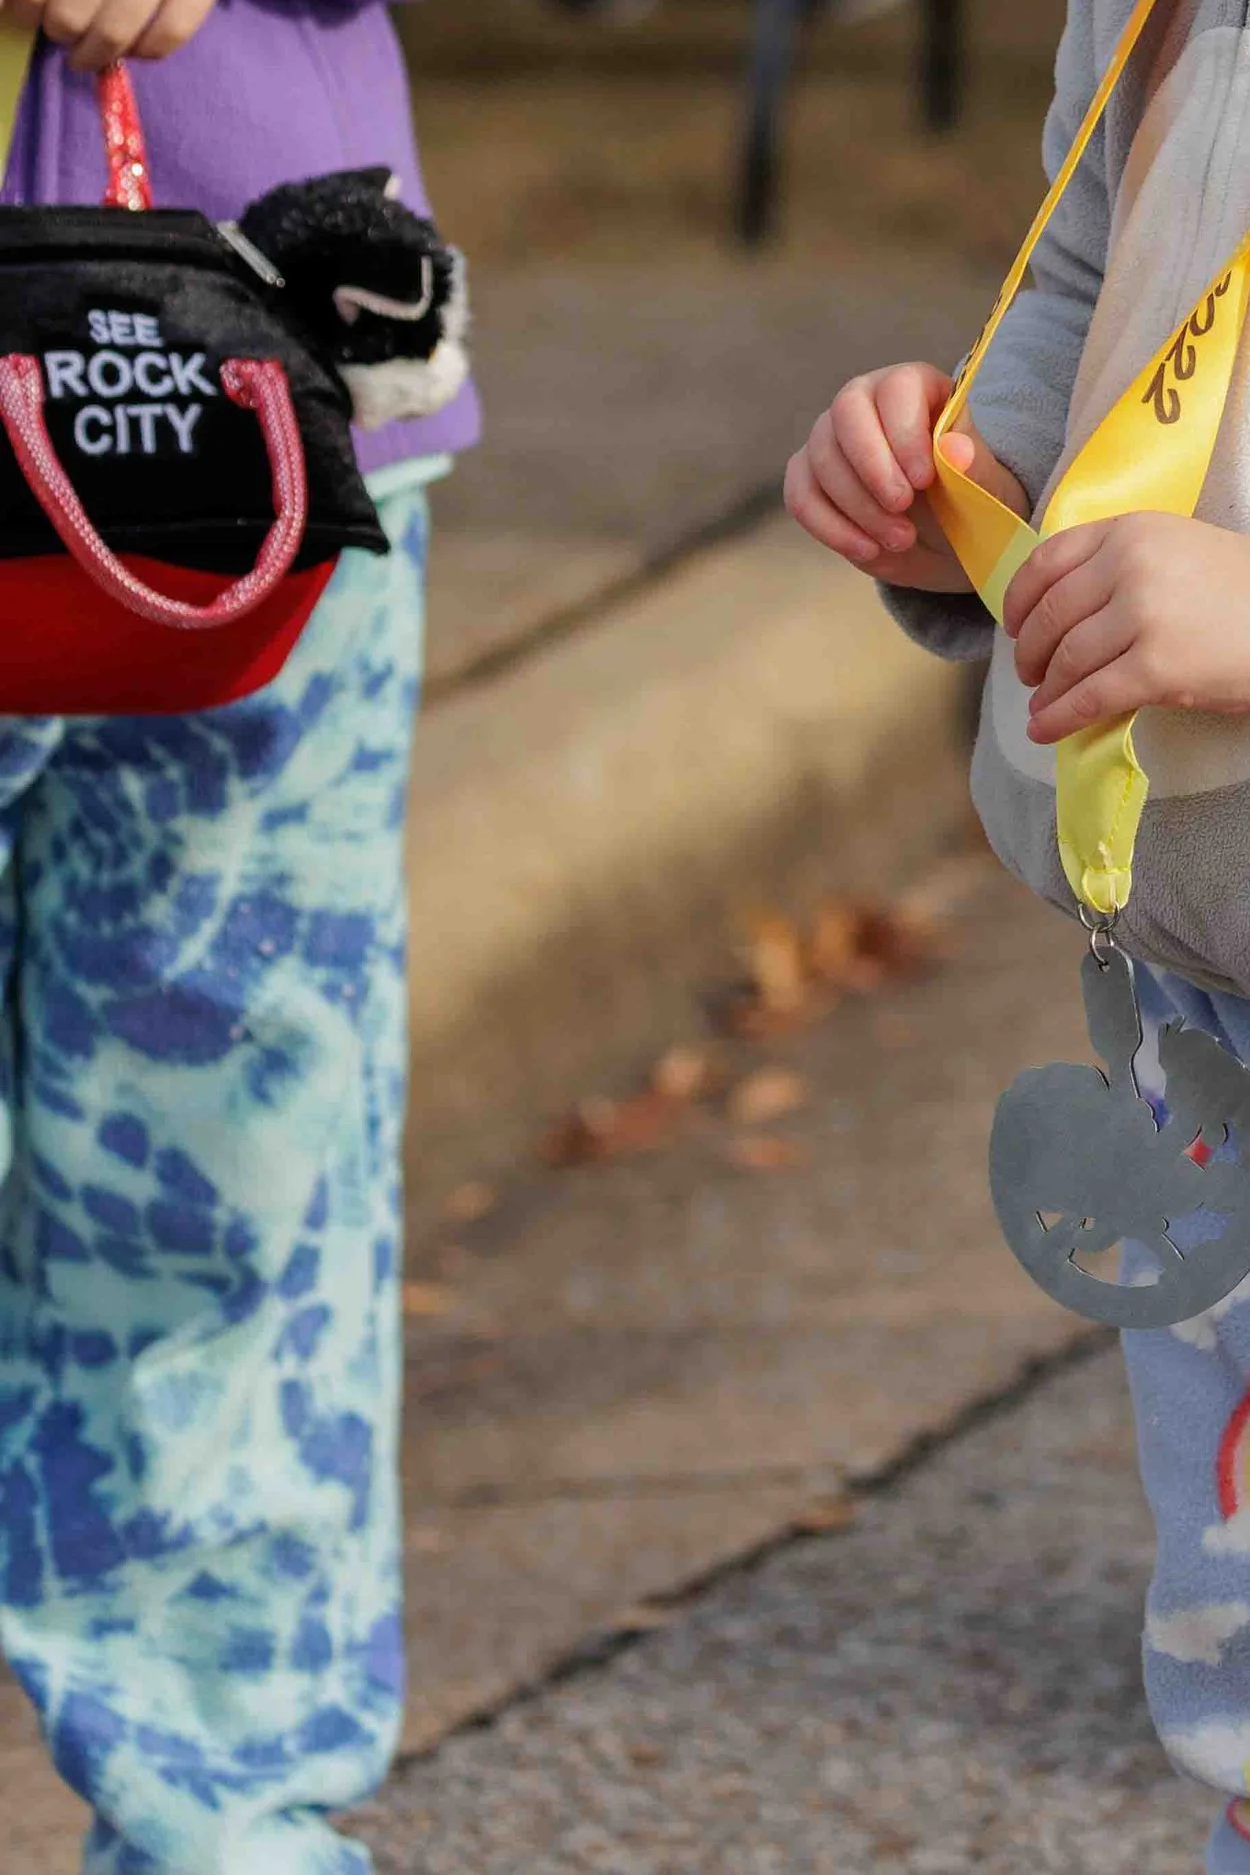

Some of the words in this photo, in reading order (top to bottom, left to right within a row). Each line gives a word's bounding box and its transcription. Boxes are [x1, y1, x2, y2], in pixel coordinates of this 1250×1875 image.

[88, 310, 163, 347] SEE
[43, 351, 218, 399] ROCK
[74, 404, 203, 455] CITY
